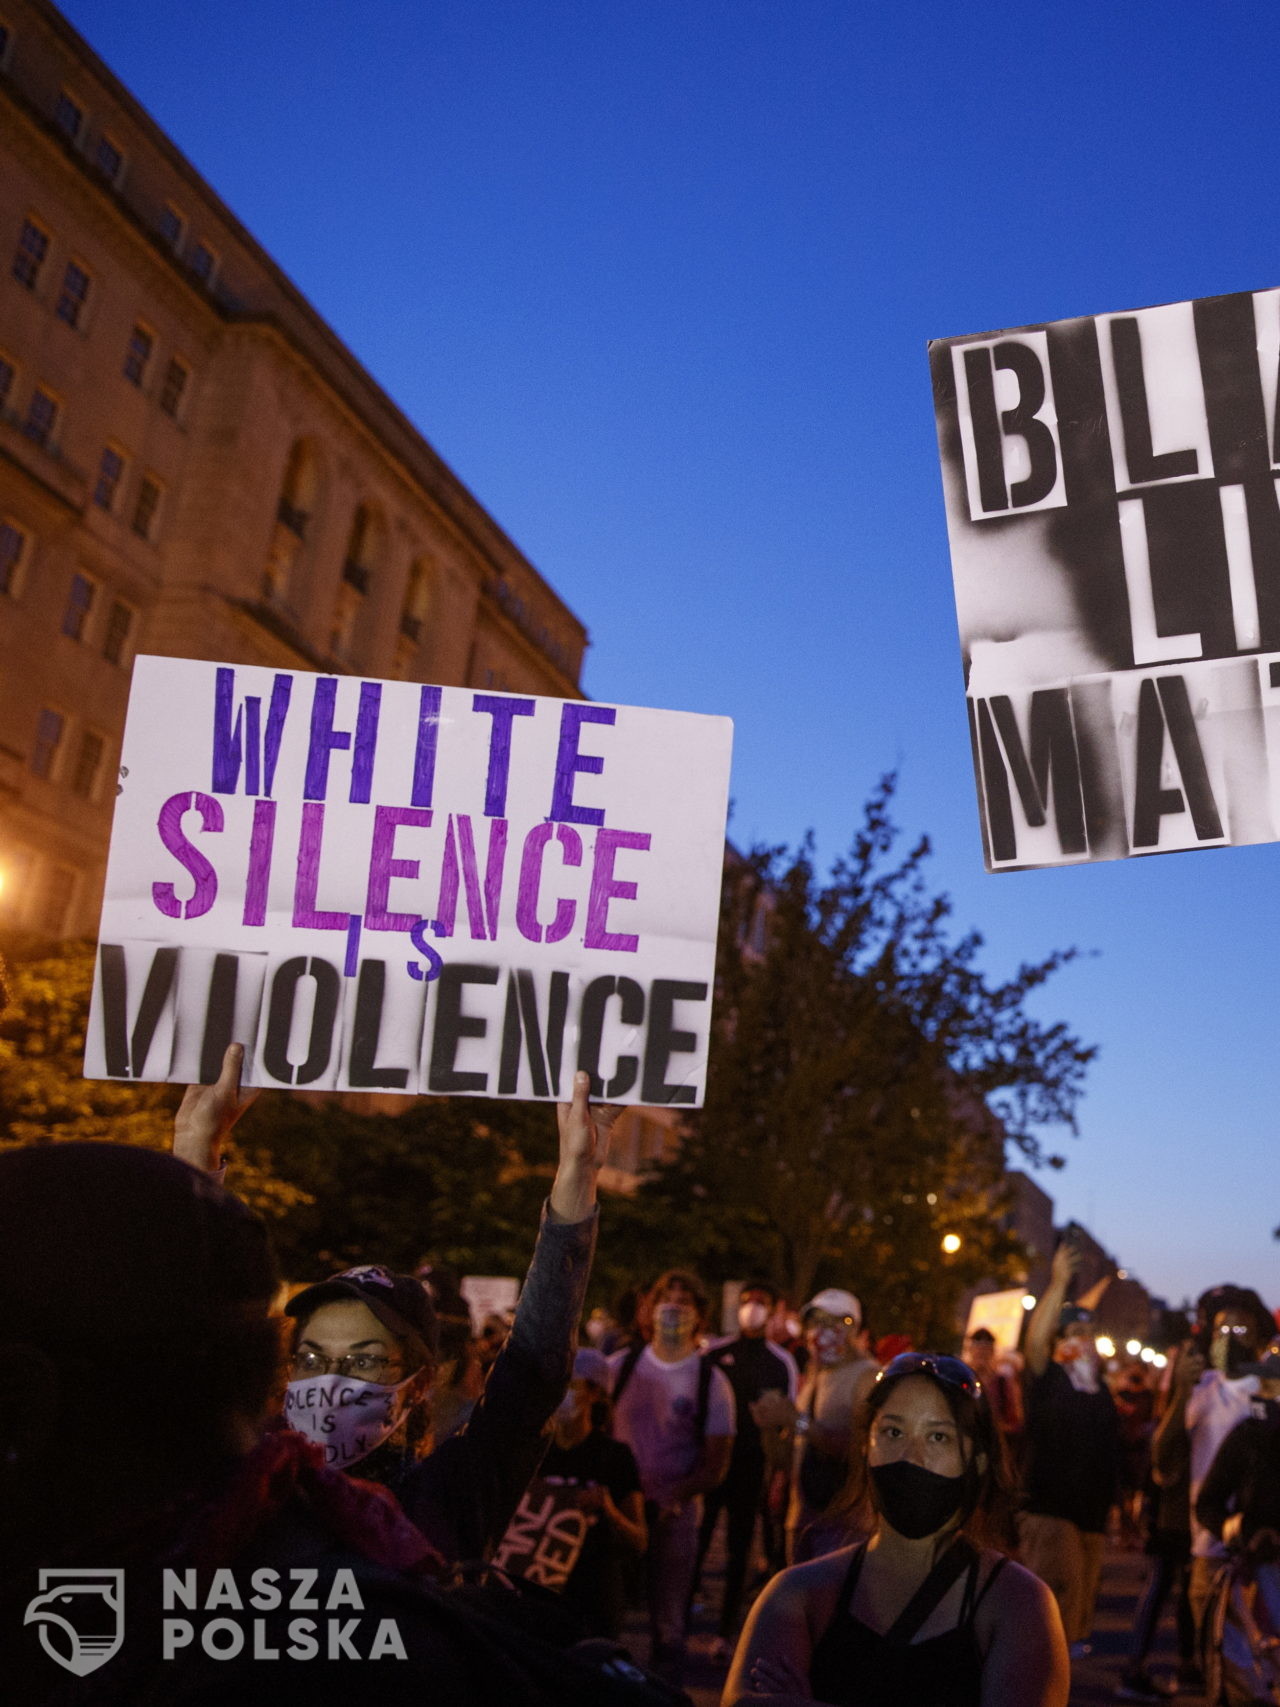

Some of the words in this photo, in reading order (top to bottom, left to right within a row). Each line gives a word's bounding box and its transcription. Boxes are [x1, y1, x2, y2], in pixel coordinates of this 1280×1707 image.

[212, 667, 617, 825] WHITE
[151, 791, 652, 952] SILENCE
[344, 914, 447, 982] IS
[100, 943, 709, 1105] VIOLENCE
[312, 1414, 337, 1433] IS
